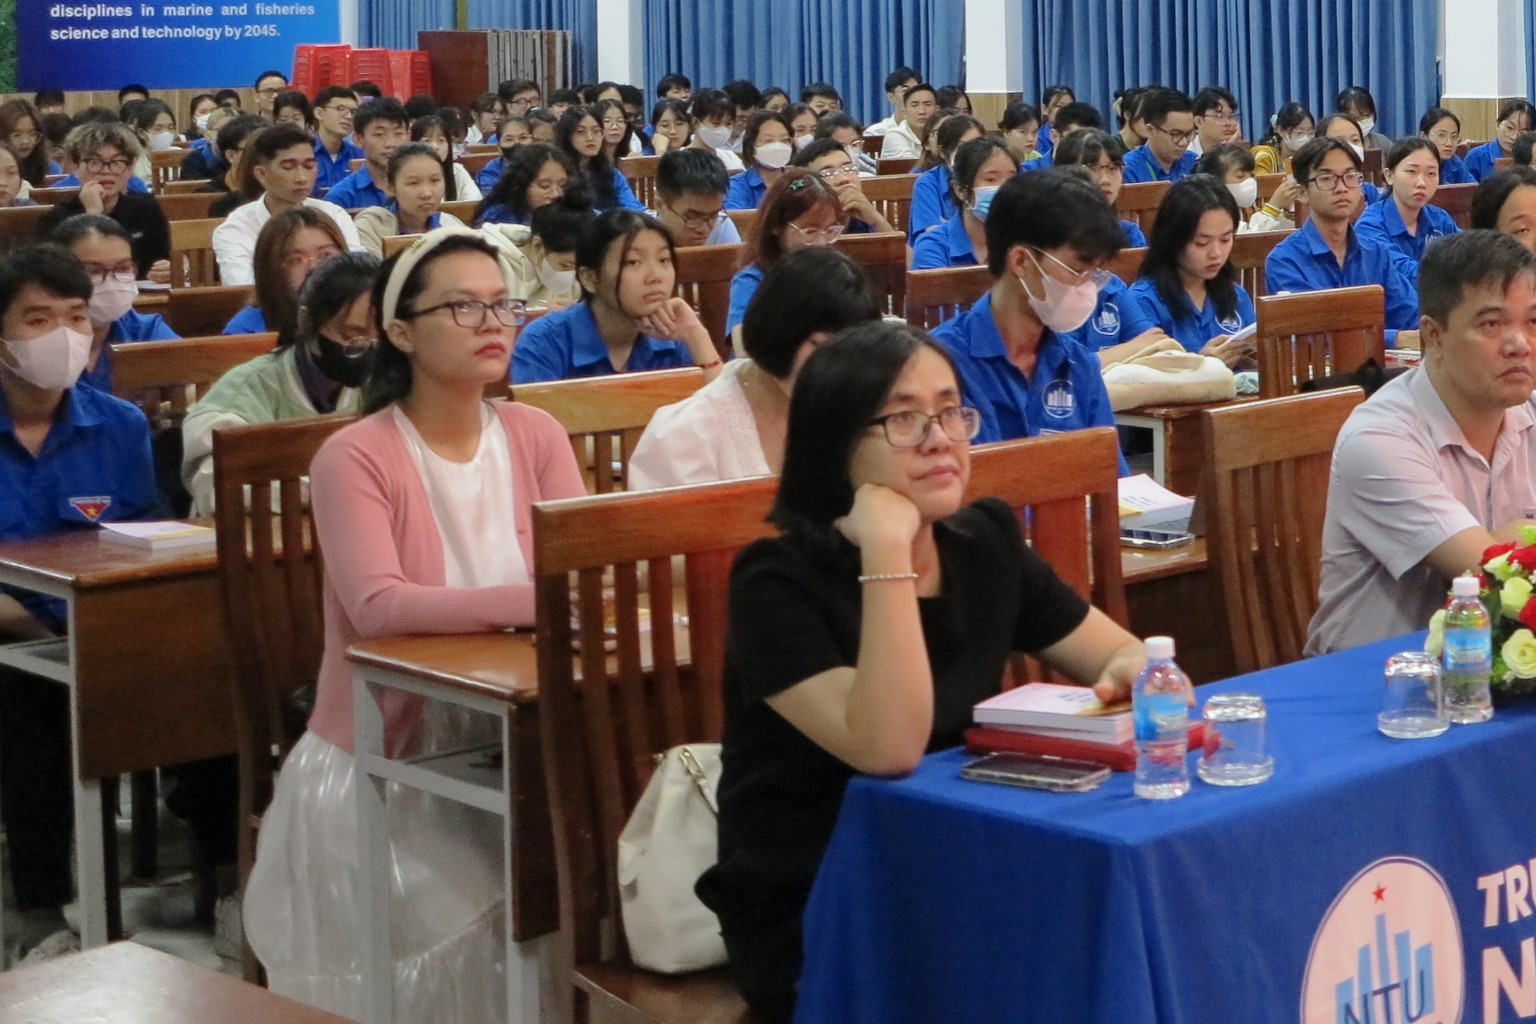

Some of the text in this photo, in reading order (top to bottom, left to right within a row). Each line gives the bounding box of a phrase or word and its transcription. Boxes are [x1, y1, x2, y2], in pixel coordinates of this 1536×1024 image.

[50, 2, 315, 20] disciplines in marine and fisheries
[50, 24, 280, 40] science and technology by 2045.
